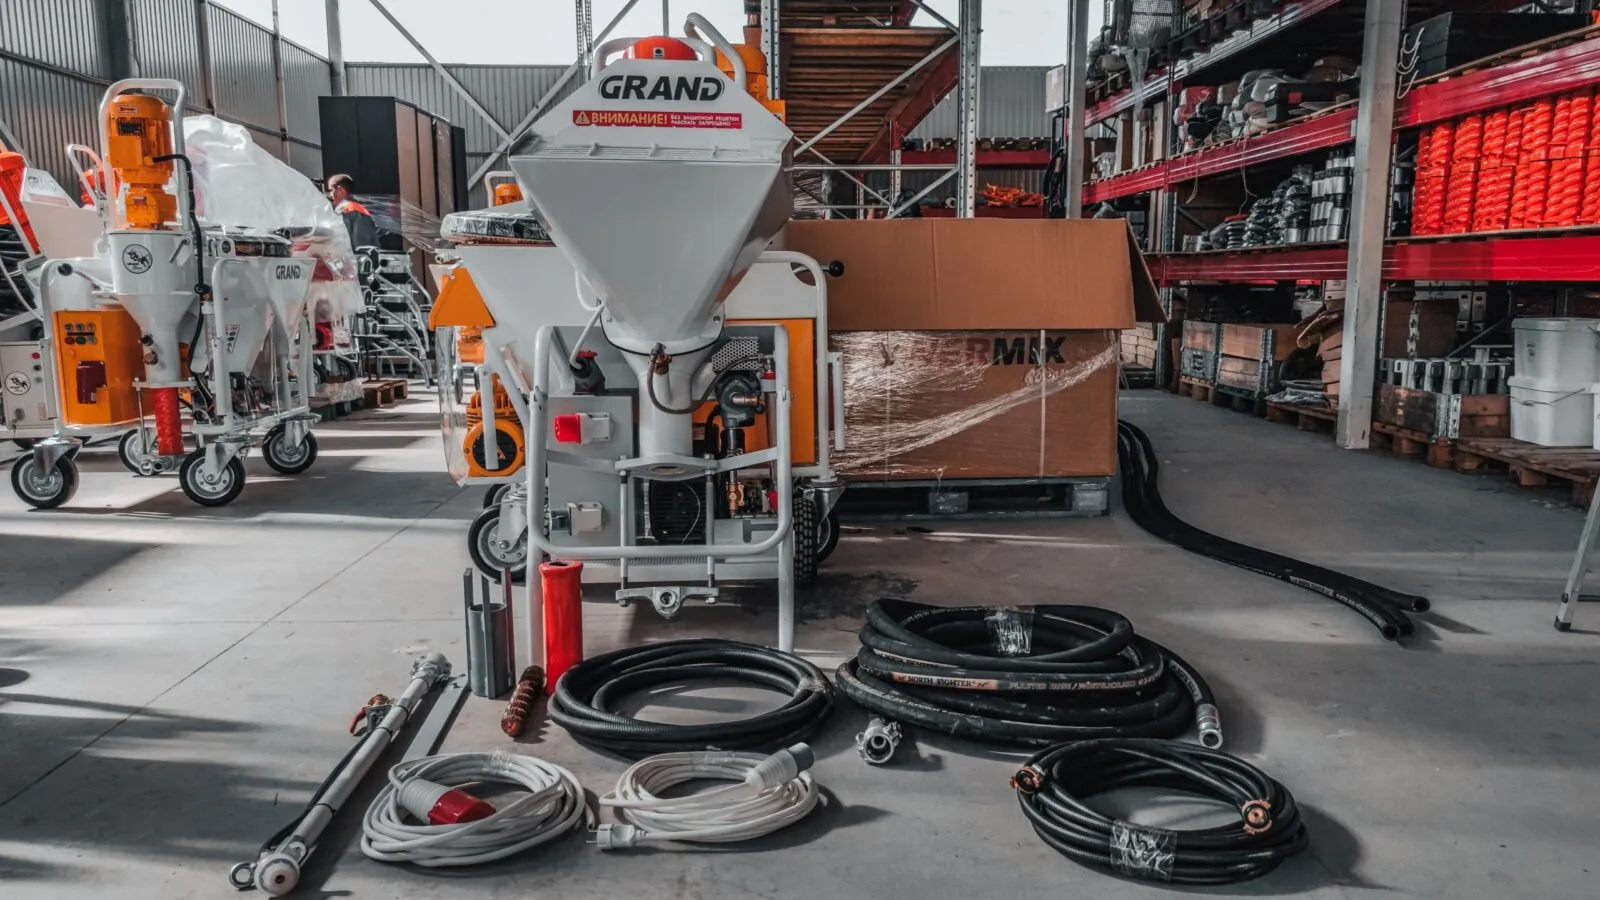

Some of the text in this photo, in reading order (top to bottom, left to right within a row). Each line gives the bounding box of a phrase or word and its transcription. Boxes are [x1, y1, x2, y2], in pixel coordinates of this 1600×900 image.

[598, 75, 725, 101] GRAND
[591, 112, 668, 125] ВНИМАНИЕ!
[275, 265, 301, 280] GRAND
[908, 674, 934, 685] NORTH
